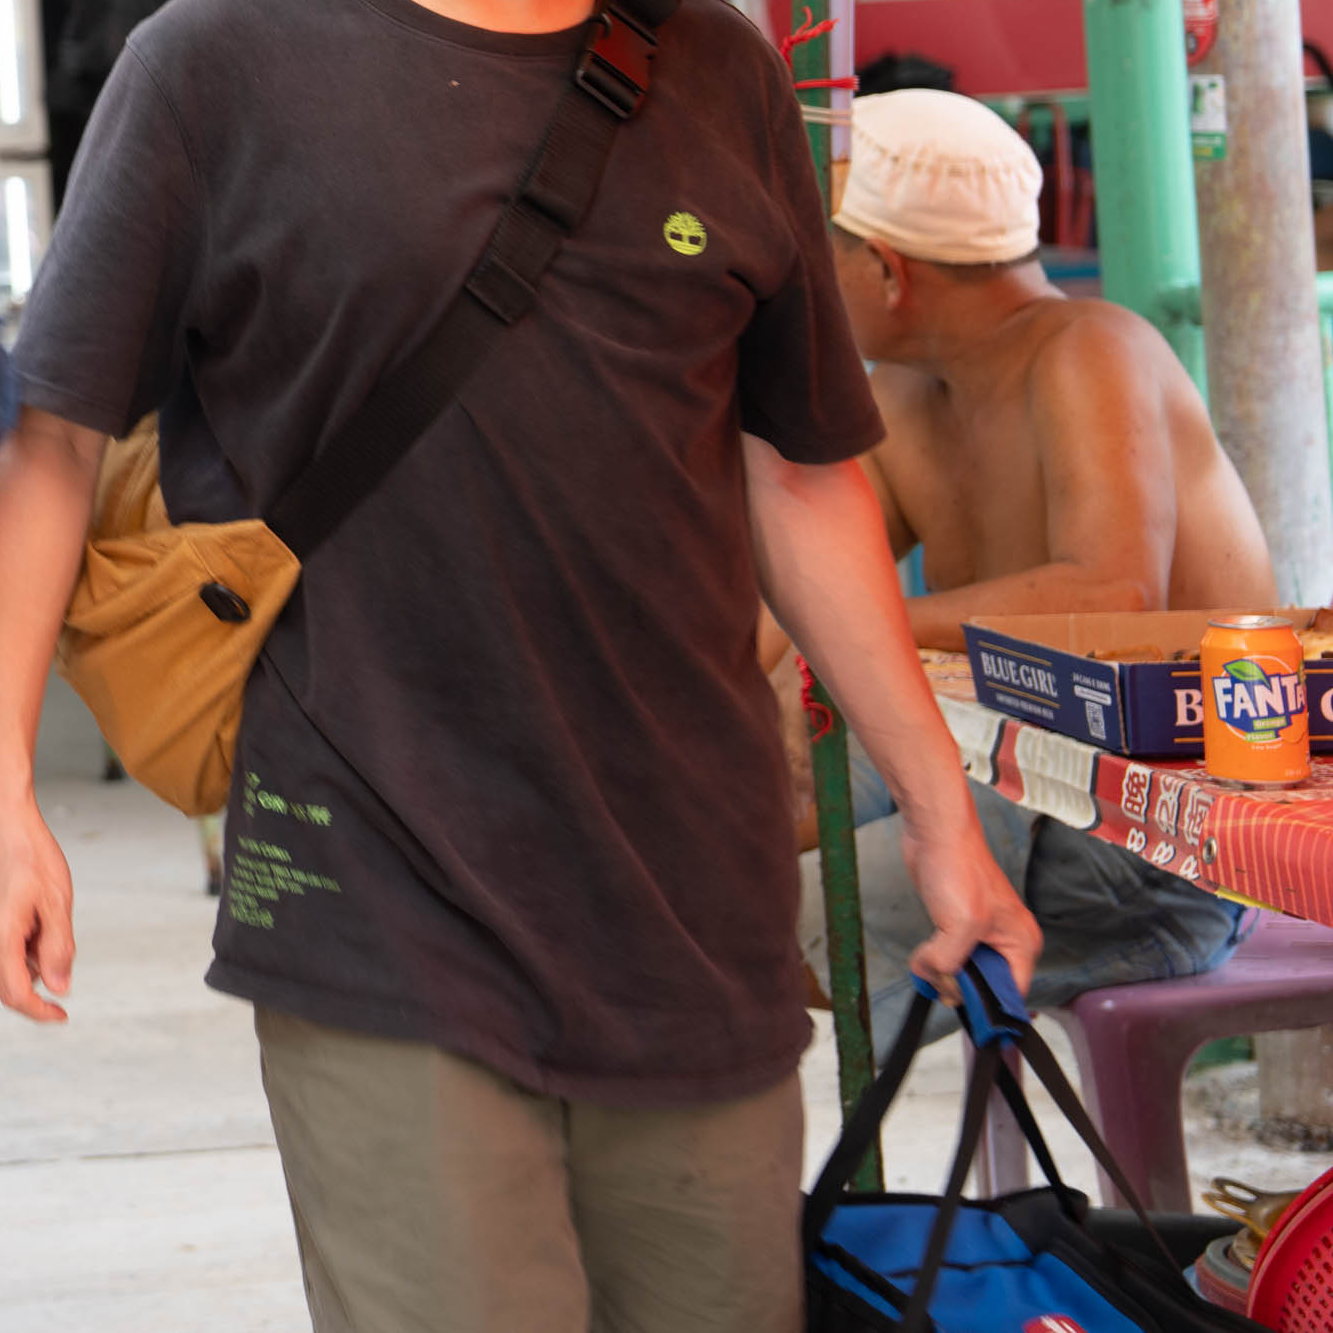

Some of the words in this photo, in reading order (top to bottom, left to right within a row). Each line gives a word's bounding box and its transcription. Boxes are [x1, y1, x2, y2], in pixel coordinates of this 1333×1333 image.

[981, 651, 1021, 686] BLUE
[1019, 664, 1058, 698] GIRL
[1213, 674, 1306, 719] FANTA
